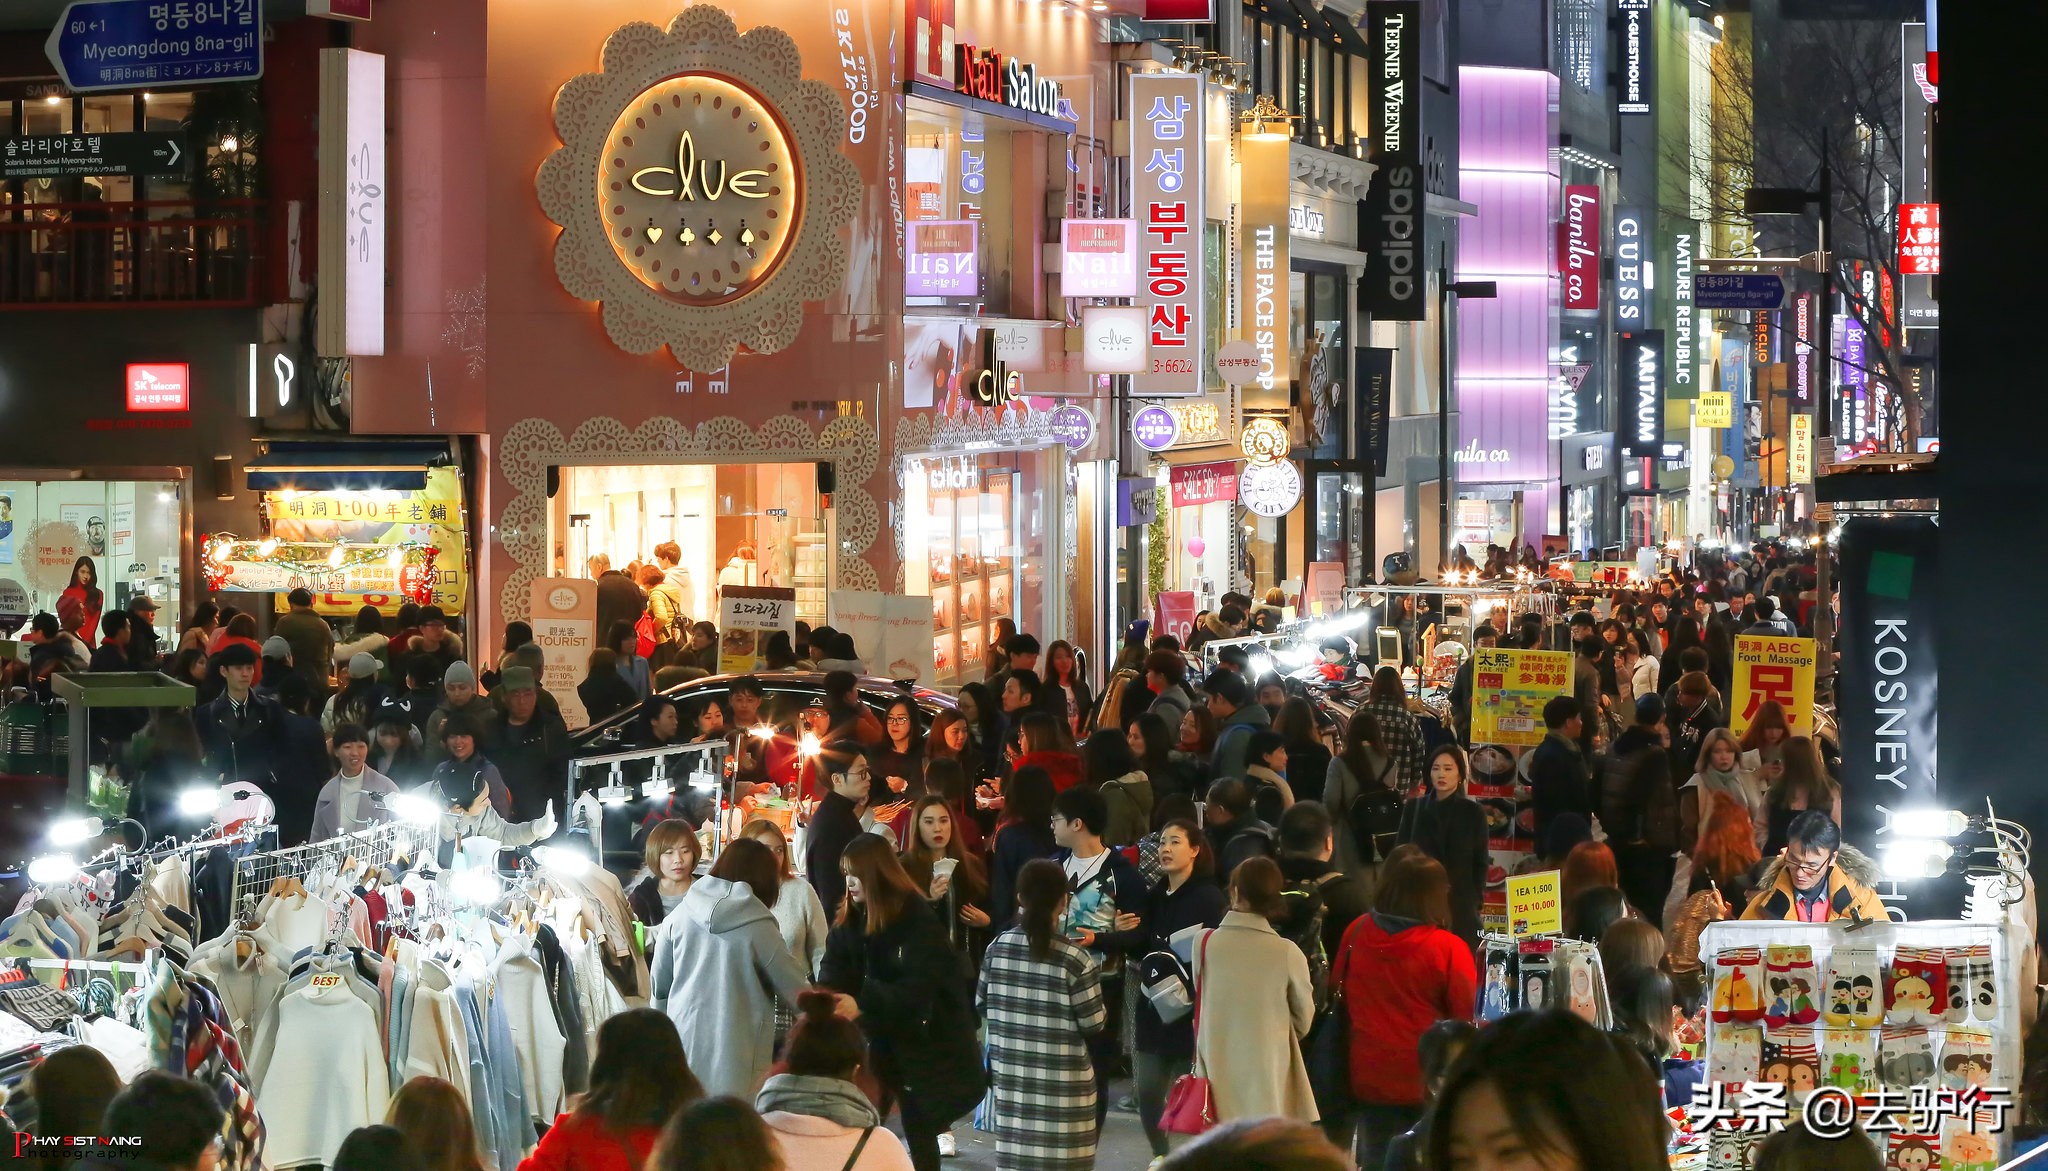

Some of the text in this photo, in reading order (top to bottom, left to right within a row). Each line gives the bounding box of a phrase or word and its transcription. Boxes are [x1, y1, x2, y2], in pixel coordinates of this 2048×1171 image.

[150, 1, 253, 31] 명동8나길
[71, 21, 86, 34] 60
[84, 32, 253, 62] Myeongdong 8na-gil
[1628, 10, 1640, 101] K-GUESTHOUSE
[963, 43, 1003, 103] Nail
[1009, 56, 1059, 117] Salon
[1385, 13, 1403, 152] TEENIE WEENIE
[5, 158, 25, 166] Solaria
[43, 157, 60, 165] Seoul
[61, 157, 103, 165] Myeong-dong
[631, 130, 770, 201] clue
[358, 142, 381, 263] clue
[1382, 166, 1413, 300] adidas
[1569, 193, 1595, 303] banila co.
[1067, 252, 1132, 274] Nail
[1618, 218, 1639, 320] GUESS
[1697, 290, 1746, 299] Myeongdong
[1256, 225, 1274, 390] THE FACE SHOP
[1676, 234, 1691, 384] NATURE REPUBLIC
[1099, 328, 1133, 345] clue
[978, 328, 1019, 407] clue
[1218, 358, 1258, 367] 삼성부동산
[1564, 366, 1587, 374] GUESS
[134, 381, 181, 391] SK telecom
[1639, 346, 1655, 441] ARITAUM
[1703, 396, 1724, 406] mini
[1697, 408, 1729, 417] GOLD
[1842, 397, 1851, 440] LEADERS
[1454, 438, 1486, 463] nila
[1795, 430, 1805, 474] 맘스터치
[405, 568, 417, 580] 营
[405, 581, 417, 594] 丰
[732, 602, 783, 620] 오다리집
[834, 611, 880, 622] Spring Breeze
[887, 617, 928, 626] ing Breeze
[549, 626, 576, 637] 觀光客
[536, 635, 588, 647] TOURIST
[1738, 640, 1801, 654] 明洞 ABC
[1478, 652, 1509, 667] 太熙
[1738, 652, 1812, 667] Foot Massage
[1742, 665, 1797, 724] 足
[1874, 618, 1908, 790] KOSNEY
[1516, 883, 1553, 897] 1EA 1,500
[1514, 899, 1555, 914] 7EA 10,000
[312, 975, 341, 987] BEST
